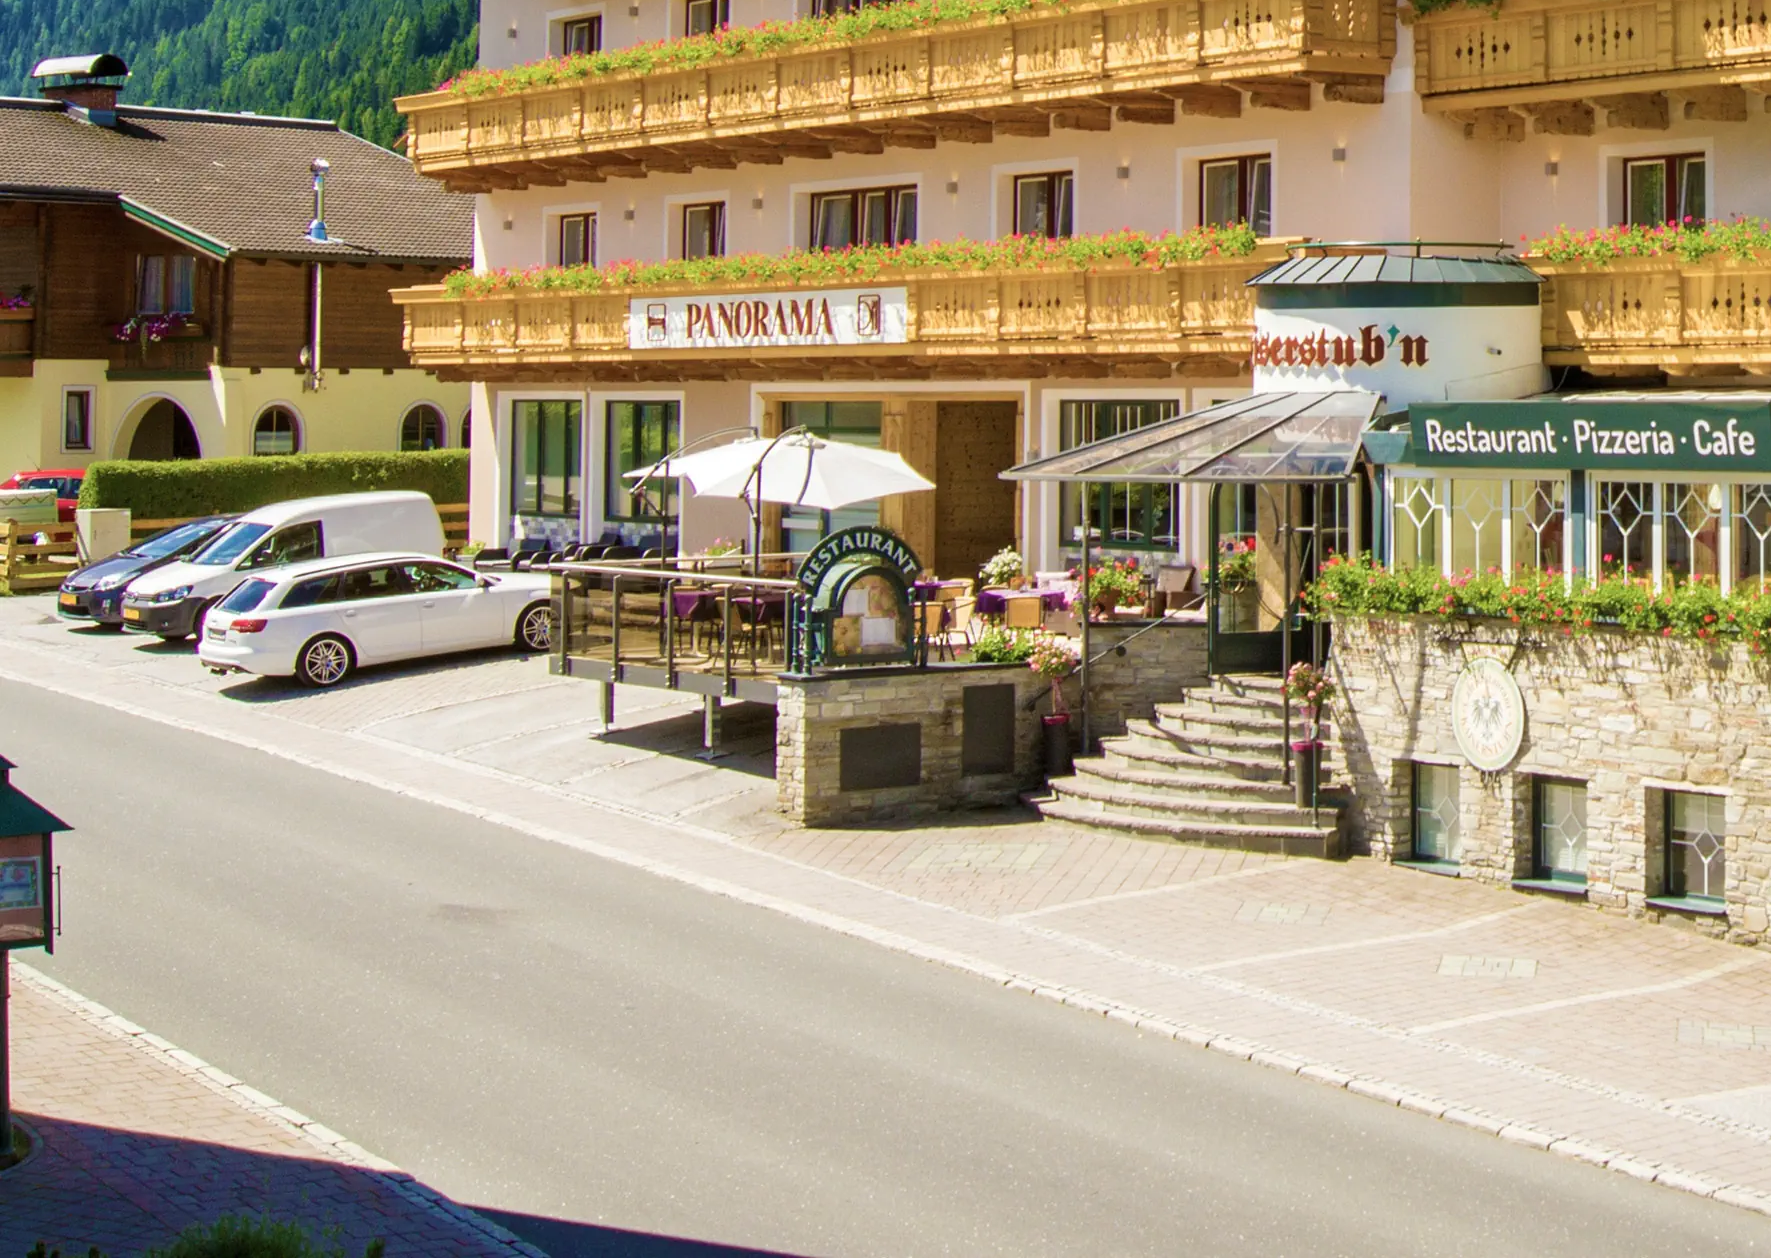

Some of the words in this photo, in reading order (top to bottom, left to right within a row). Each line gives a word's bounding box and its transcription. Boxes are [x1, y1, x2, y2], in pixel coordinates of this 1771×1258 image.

[686, 298, 834, 339] PANORAMA
[1254, 324, 1429, 367] serstub'n
[1424, 419, 1557, 453] Restaurant
[1573, 419, 1675, 455] Pizzeria
[1693, 419, 1756, 456] Cafe
[802, 532, 917, 587] RESTAURANT
